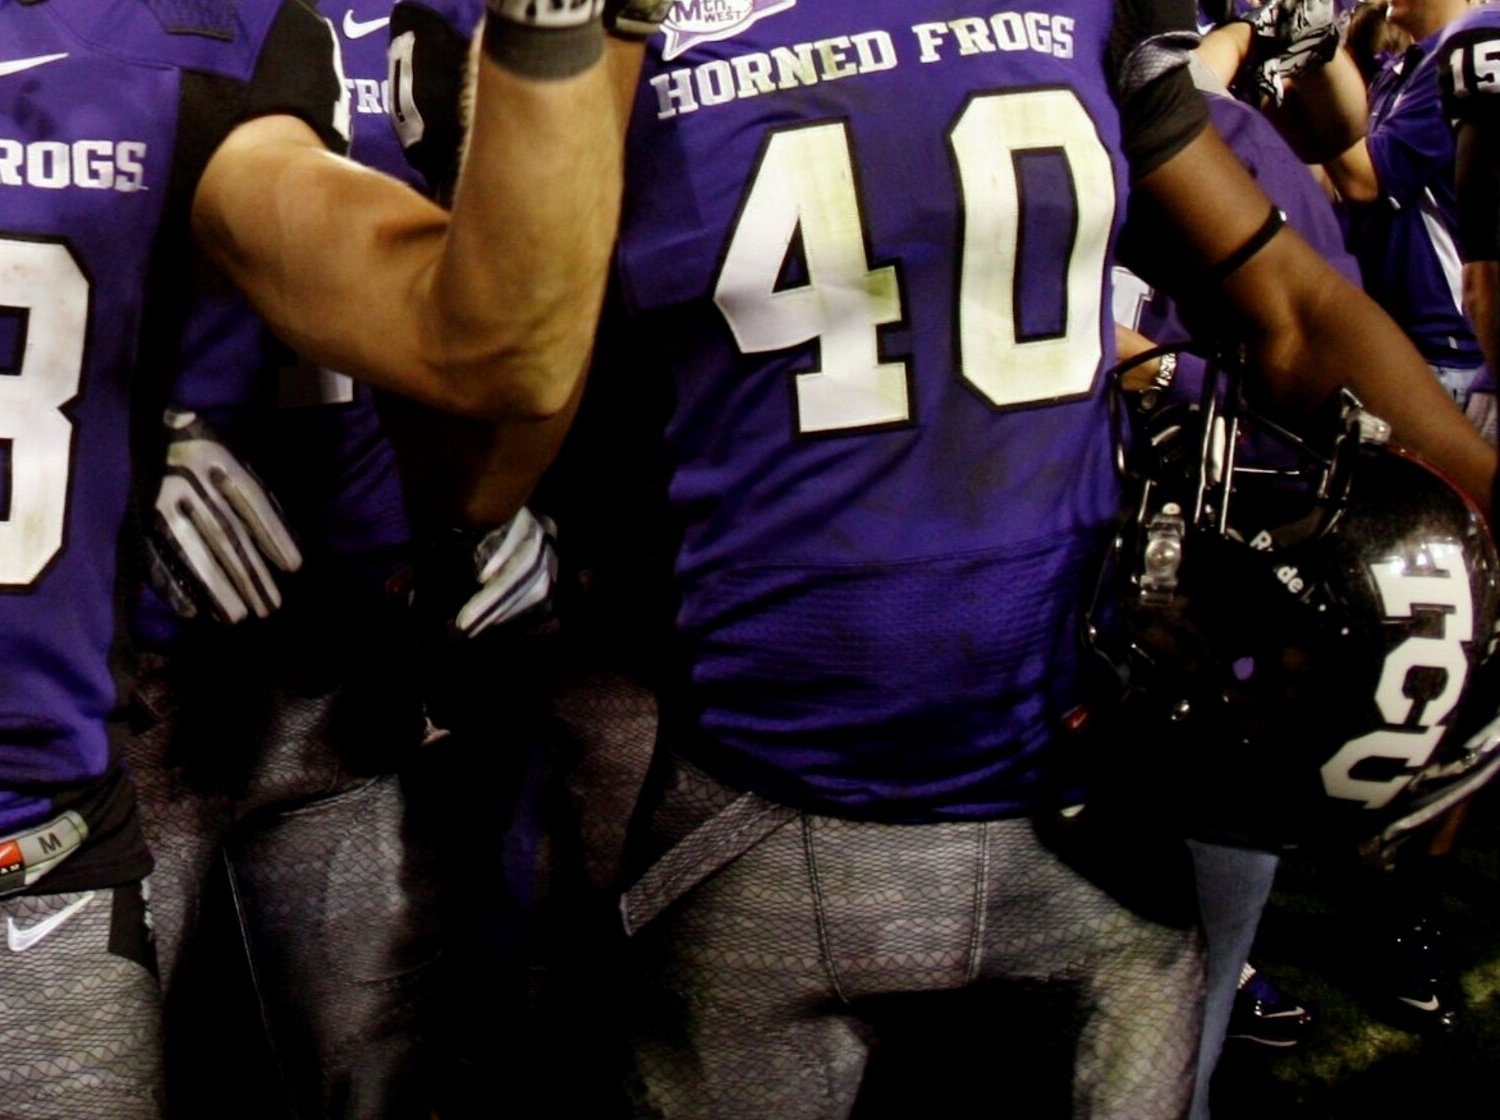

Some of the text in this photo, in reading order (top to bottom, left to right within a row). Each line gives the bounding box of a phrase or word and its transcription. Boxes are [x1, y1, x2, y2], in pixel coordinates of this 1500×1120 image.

[704, 9, 741, 23] WEST
[649, 11, 1075, 119] HORNED FROGS
[1449, 39, 1500, 98] 15
[712, 88, 1117, 433] 40
[1320, 542, 1473, 810] TCU
[37, 831, 63, 856] M
